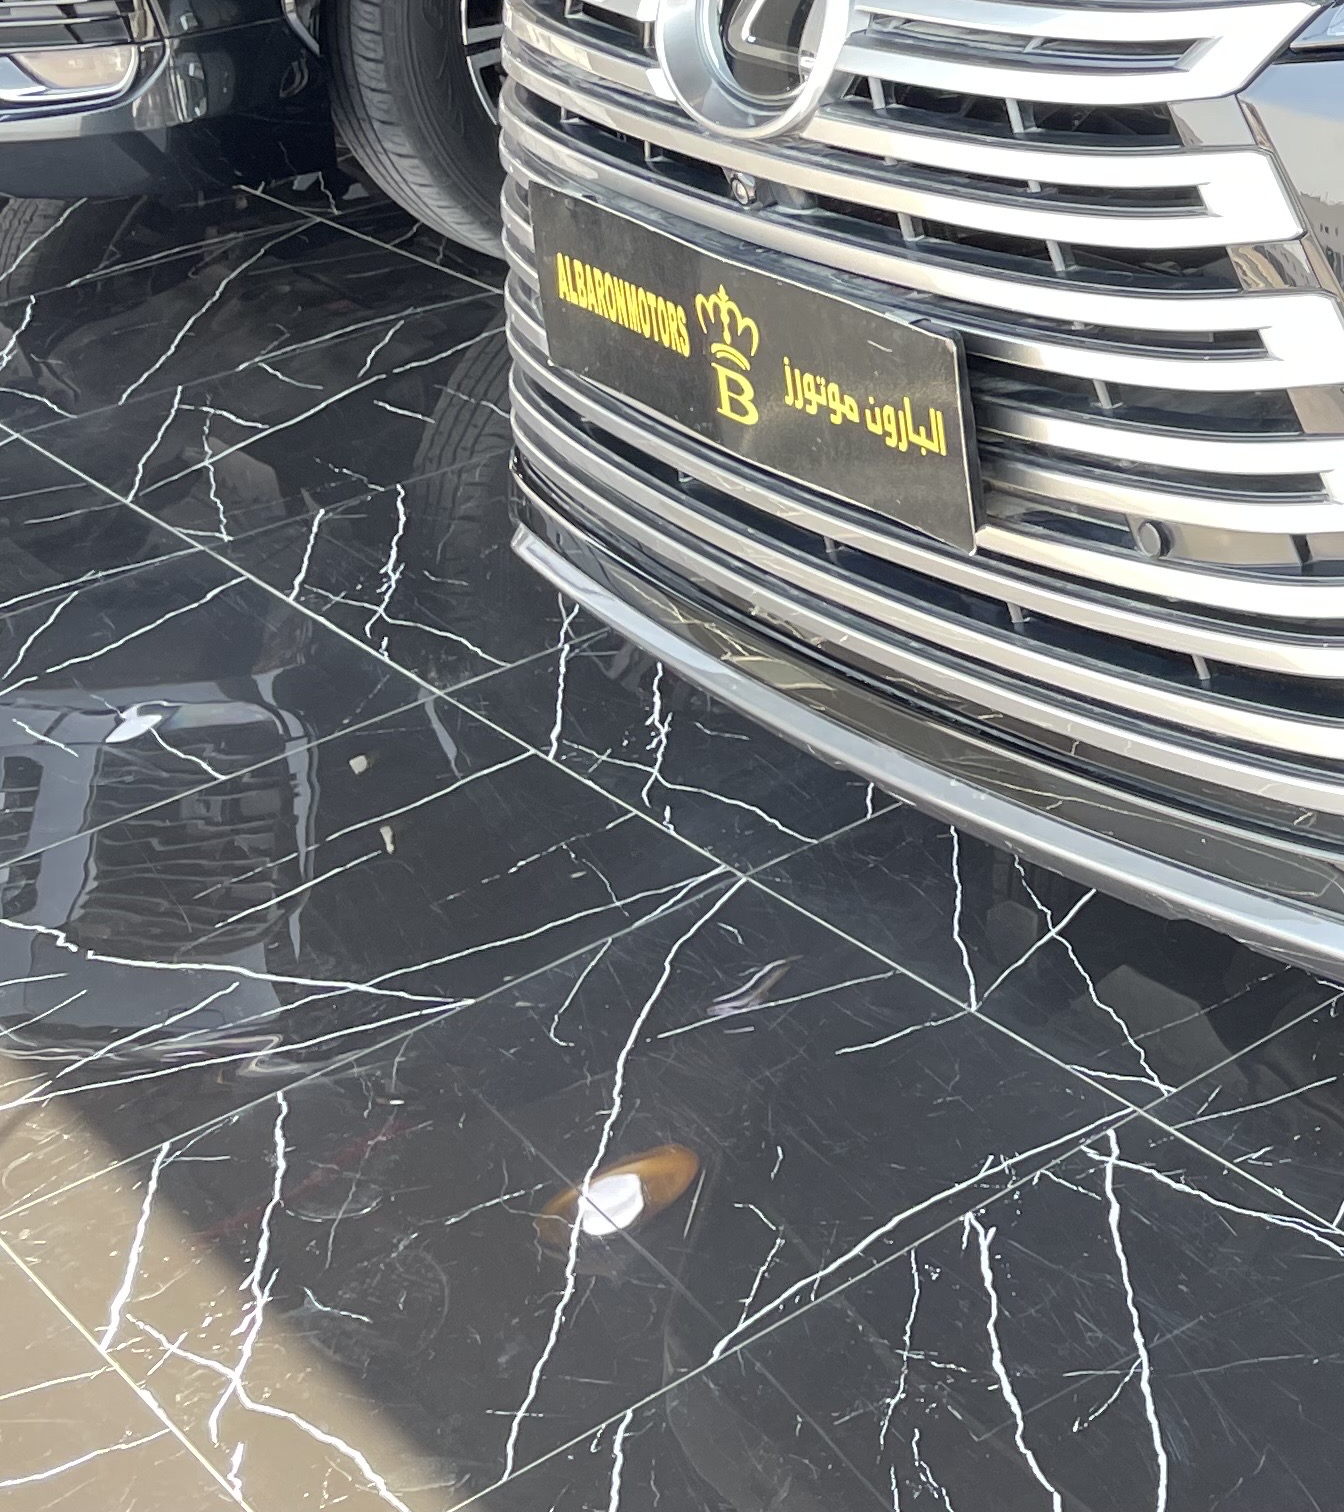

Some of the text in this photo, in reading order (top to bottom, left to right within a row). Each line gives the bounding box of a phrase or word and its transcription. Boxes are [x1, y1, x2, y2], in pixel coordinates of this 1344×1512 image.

[556, 252, 691, 358] ALBARONMOTORS
[711, 360, 760, 426] B
[782, 355, 948, 457] البارون موتورز
